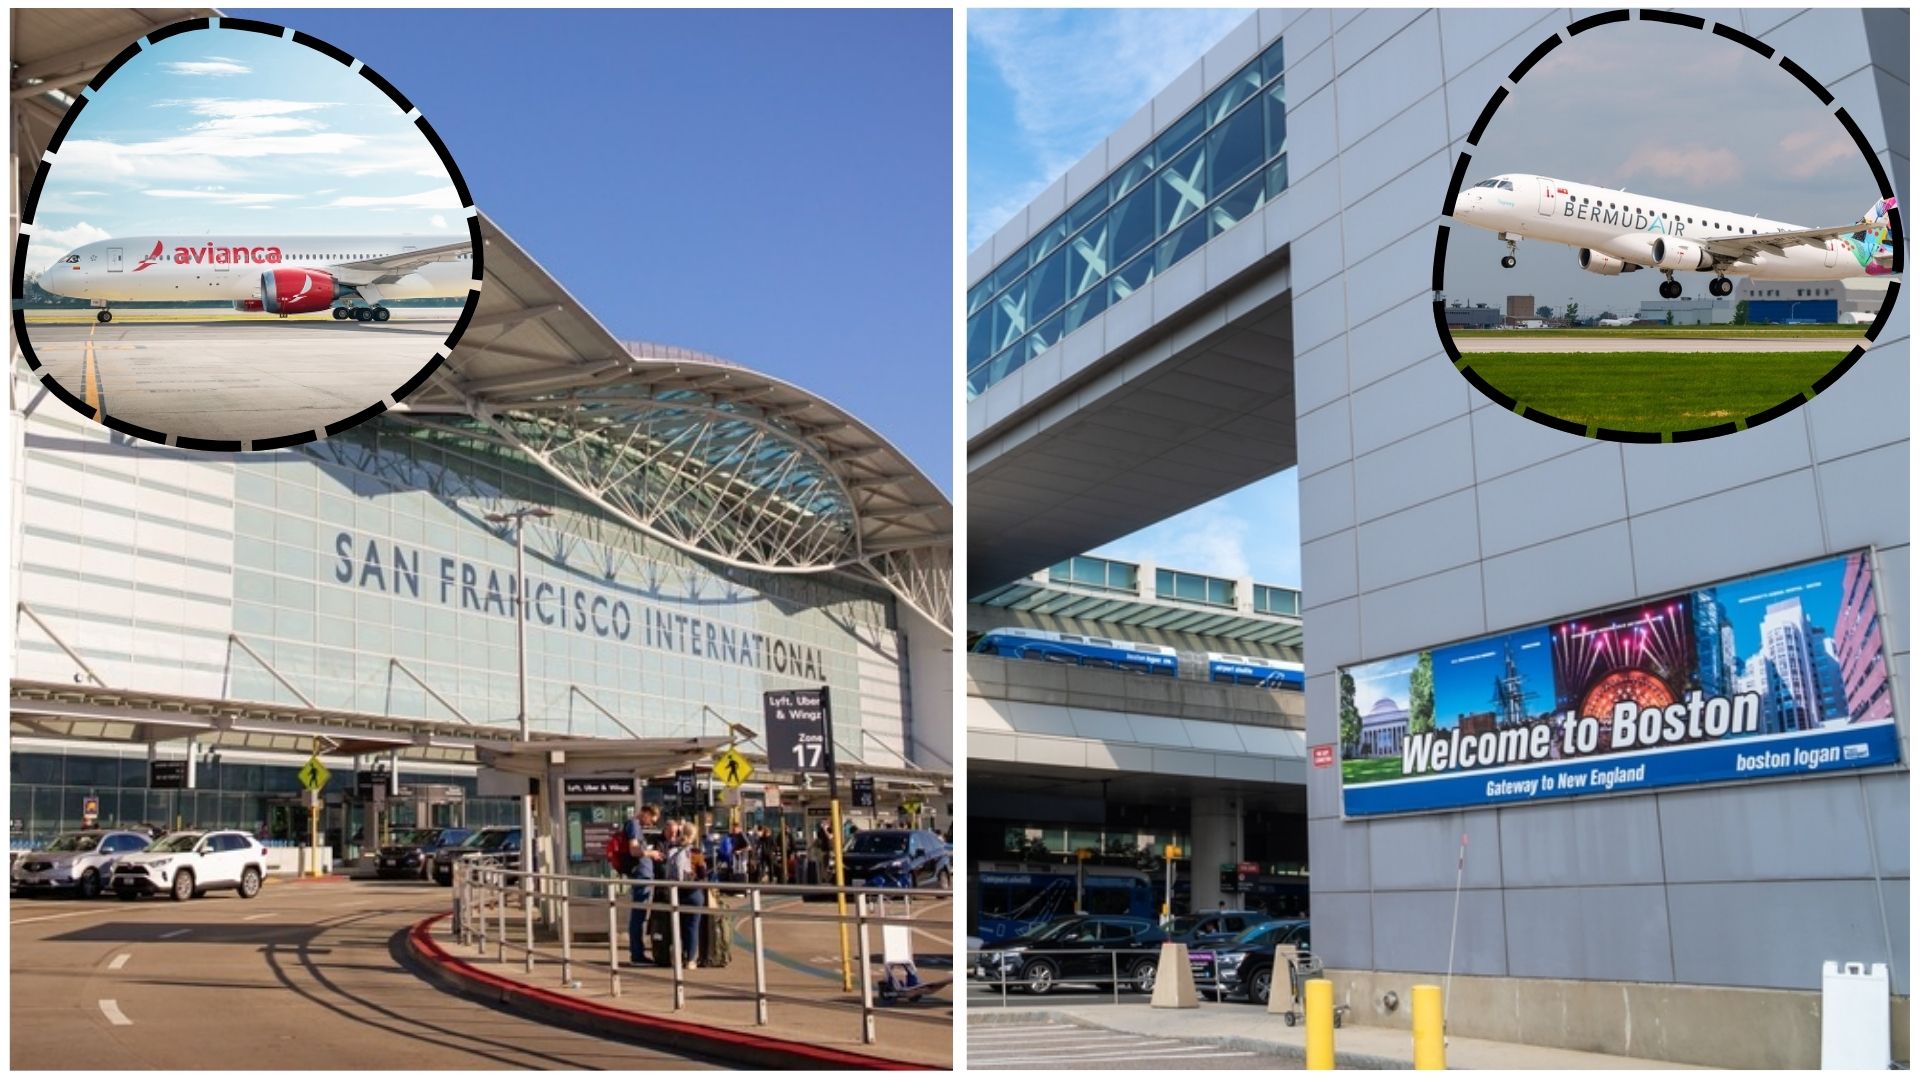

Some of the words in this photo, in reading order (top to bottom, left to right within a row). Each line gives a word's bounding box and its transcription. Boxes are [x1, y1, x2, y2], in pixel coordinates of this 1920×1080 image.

[1564, 202, 1685, 236] BERMUDAIR
[173, 241, 282, 264] avianca
[335, 532, 419, 598] SAN
[440, 557, 631, 641] FRANCISCO
[646, 607, 827, 681] INTERNATIONAL
[796, 696, 821, 706] Uber
[776, 710, 785, 719] &
[799, 733, 823, 742] Zone
[1402, 730, 1550, 776] Welcome
[1562, 711, 1600, 755] to
[1609, 688, 1760, 750] Boston
[792, 744, 822, 767] 17
[1736, 751, 1790, 771] boston
[1793, 747, 1841, 769] logan
[674, 781, 692, 793] 16
[1486, 779, 1538, 799] Gateway
[1541, 775, 1554, 791] to
[1558, 772, 1587, 789] New
[1590, 765, 1644, 789] England
